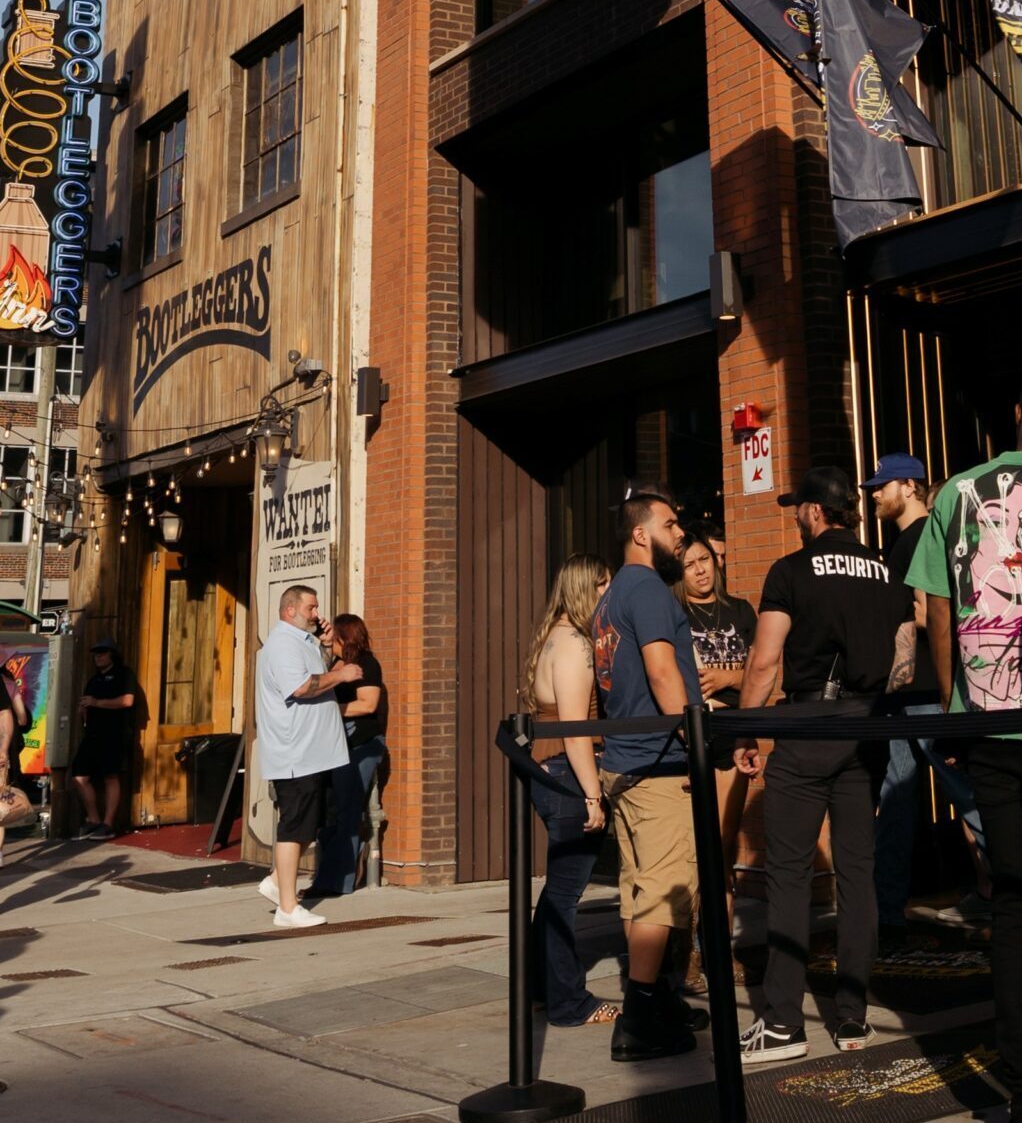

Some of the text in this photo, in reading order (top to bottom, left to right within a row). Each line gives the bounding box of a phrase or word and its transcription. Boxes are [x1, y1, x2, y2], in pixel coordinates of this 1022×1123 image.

[134, 244, 272, 394] BOOTLEGGERS
[744, 433, 769, 461] FDC
[269, 547, 326, 572] FOR BOOTLEGGING
[812, 554, 889, 584] SECURITY
